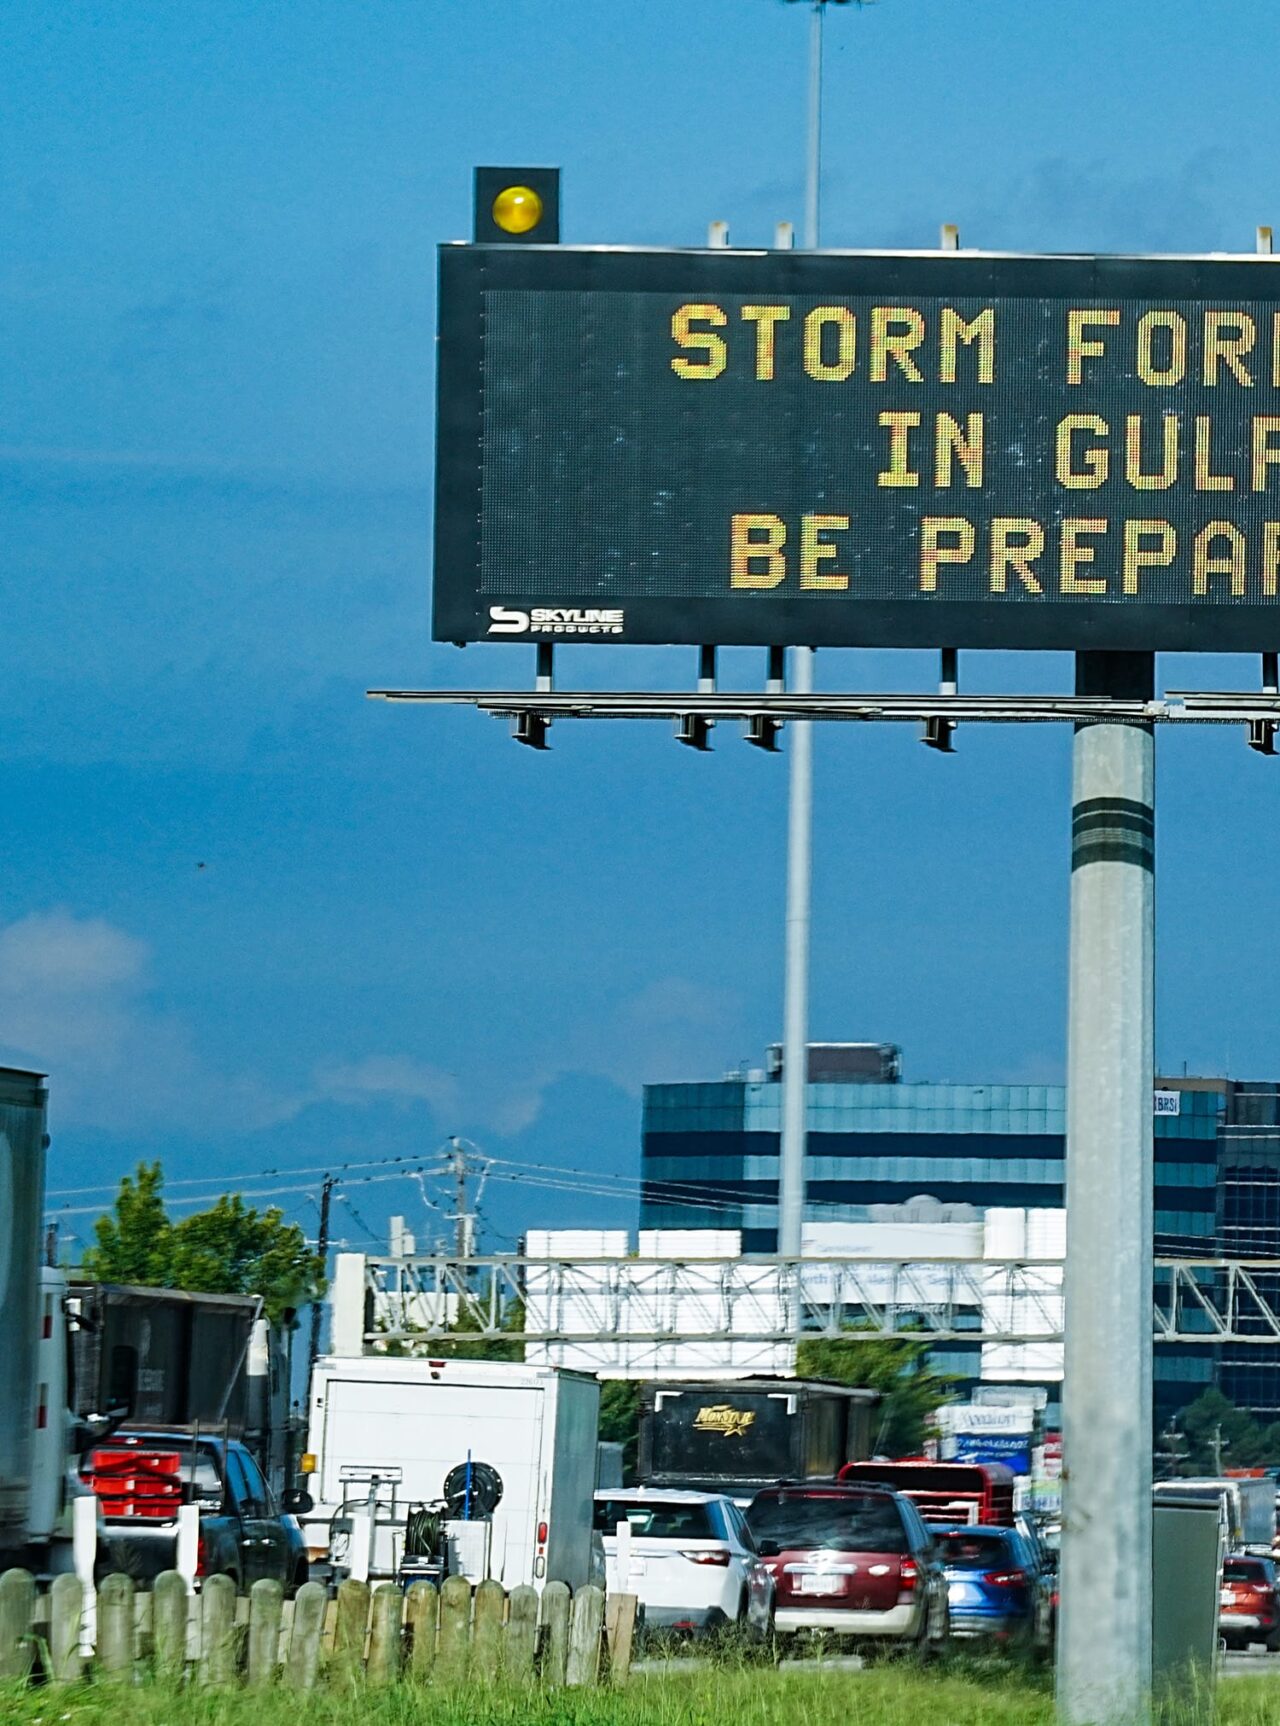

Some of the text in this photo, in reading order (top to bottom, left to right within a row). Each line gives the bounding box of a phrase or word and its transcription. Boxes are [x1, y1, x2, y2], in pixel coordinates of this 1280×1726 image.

[671, 304, 994, 383] STORM
[878, 411, 984, 487] IN
[731, 514, 849, 589] BE
[530, 608, 624, 622] SKYLINE
[530, 625, 624, 634] PRODUCTS
